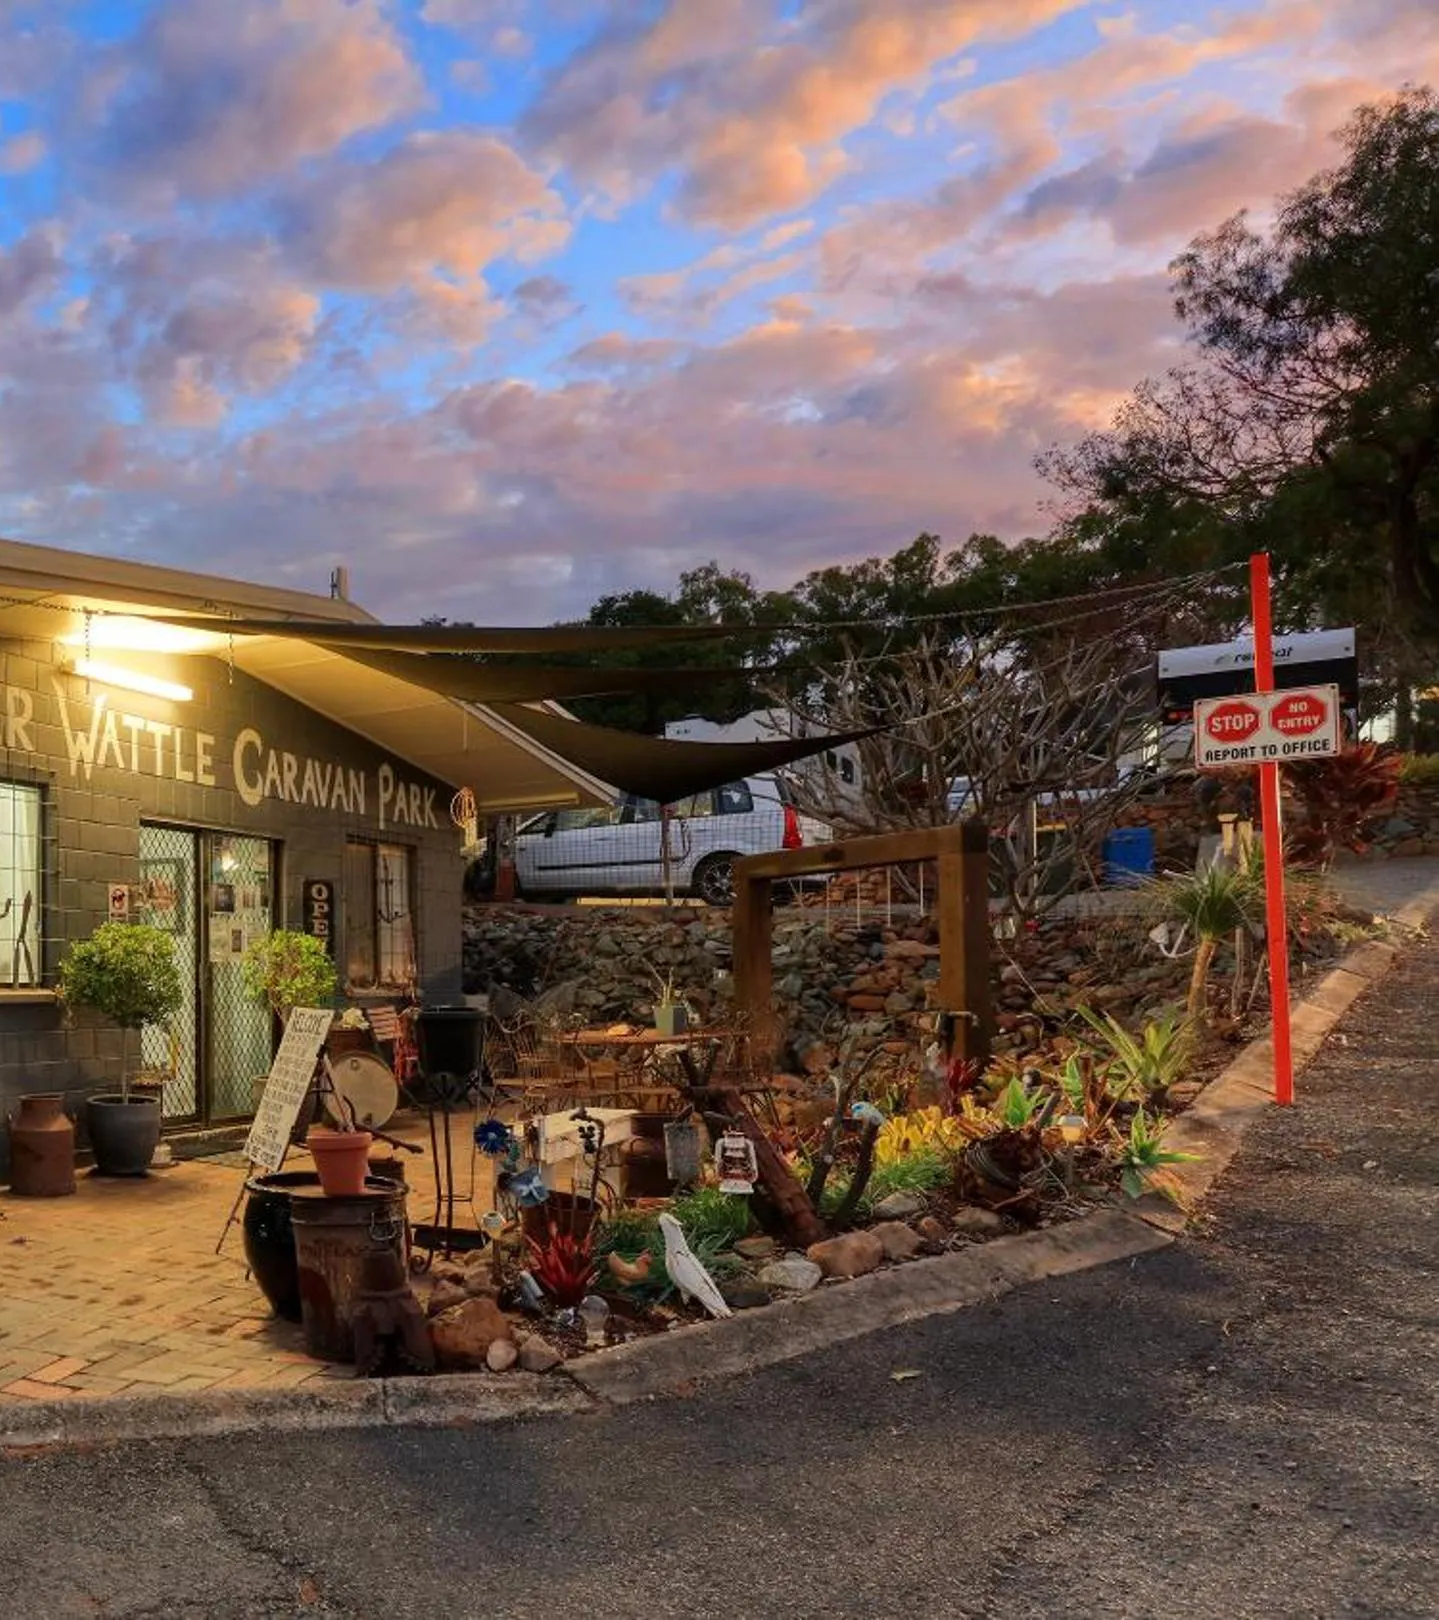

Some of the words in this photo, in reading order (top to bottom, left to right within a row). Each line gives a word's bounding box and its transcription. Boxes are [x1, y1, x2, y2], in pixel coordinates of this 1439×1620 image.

[1288, 701, 1309, 713] NO
[1211, 713, 1256, 733] STOP
[1277, 715, 1321, 730] ENTRY
[51, 676, 216, 786] WATTLE
[233, 728, 365, 815] CARAVAN
[378, 763, 438, 830] PARK
[1205, 746, 1256, 763] REPORT
[1260, 742, 1278, 758] TO
[1282, 738, 1331, 755] OFFICE
[311, 883, 329, 937] OPE
